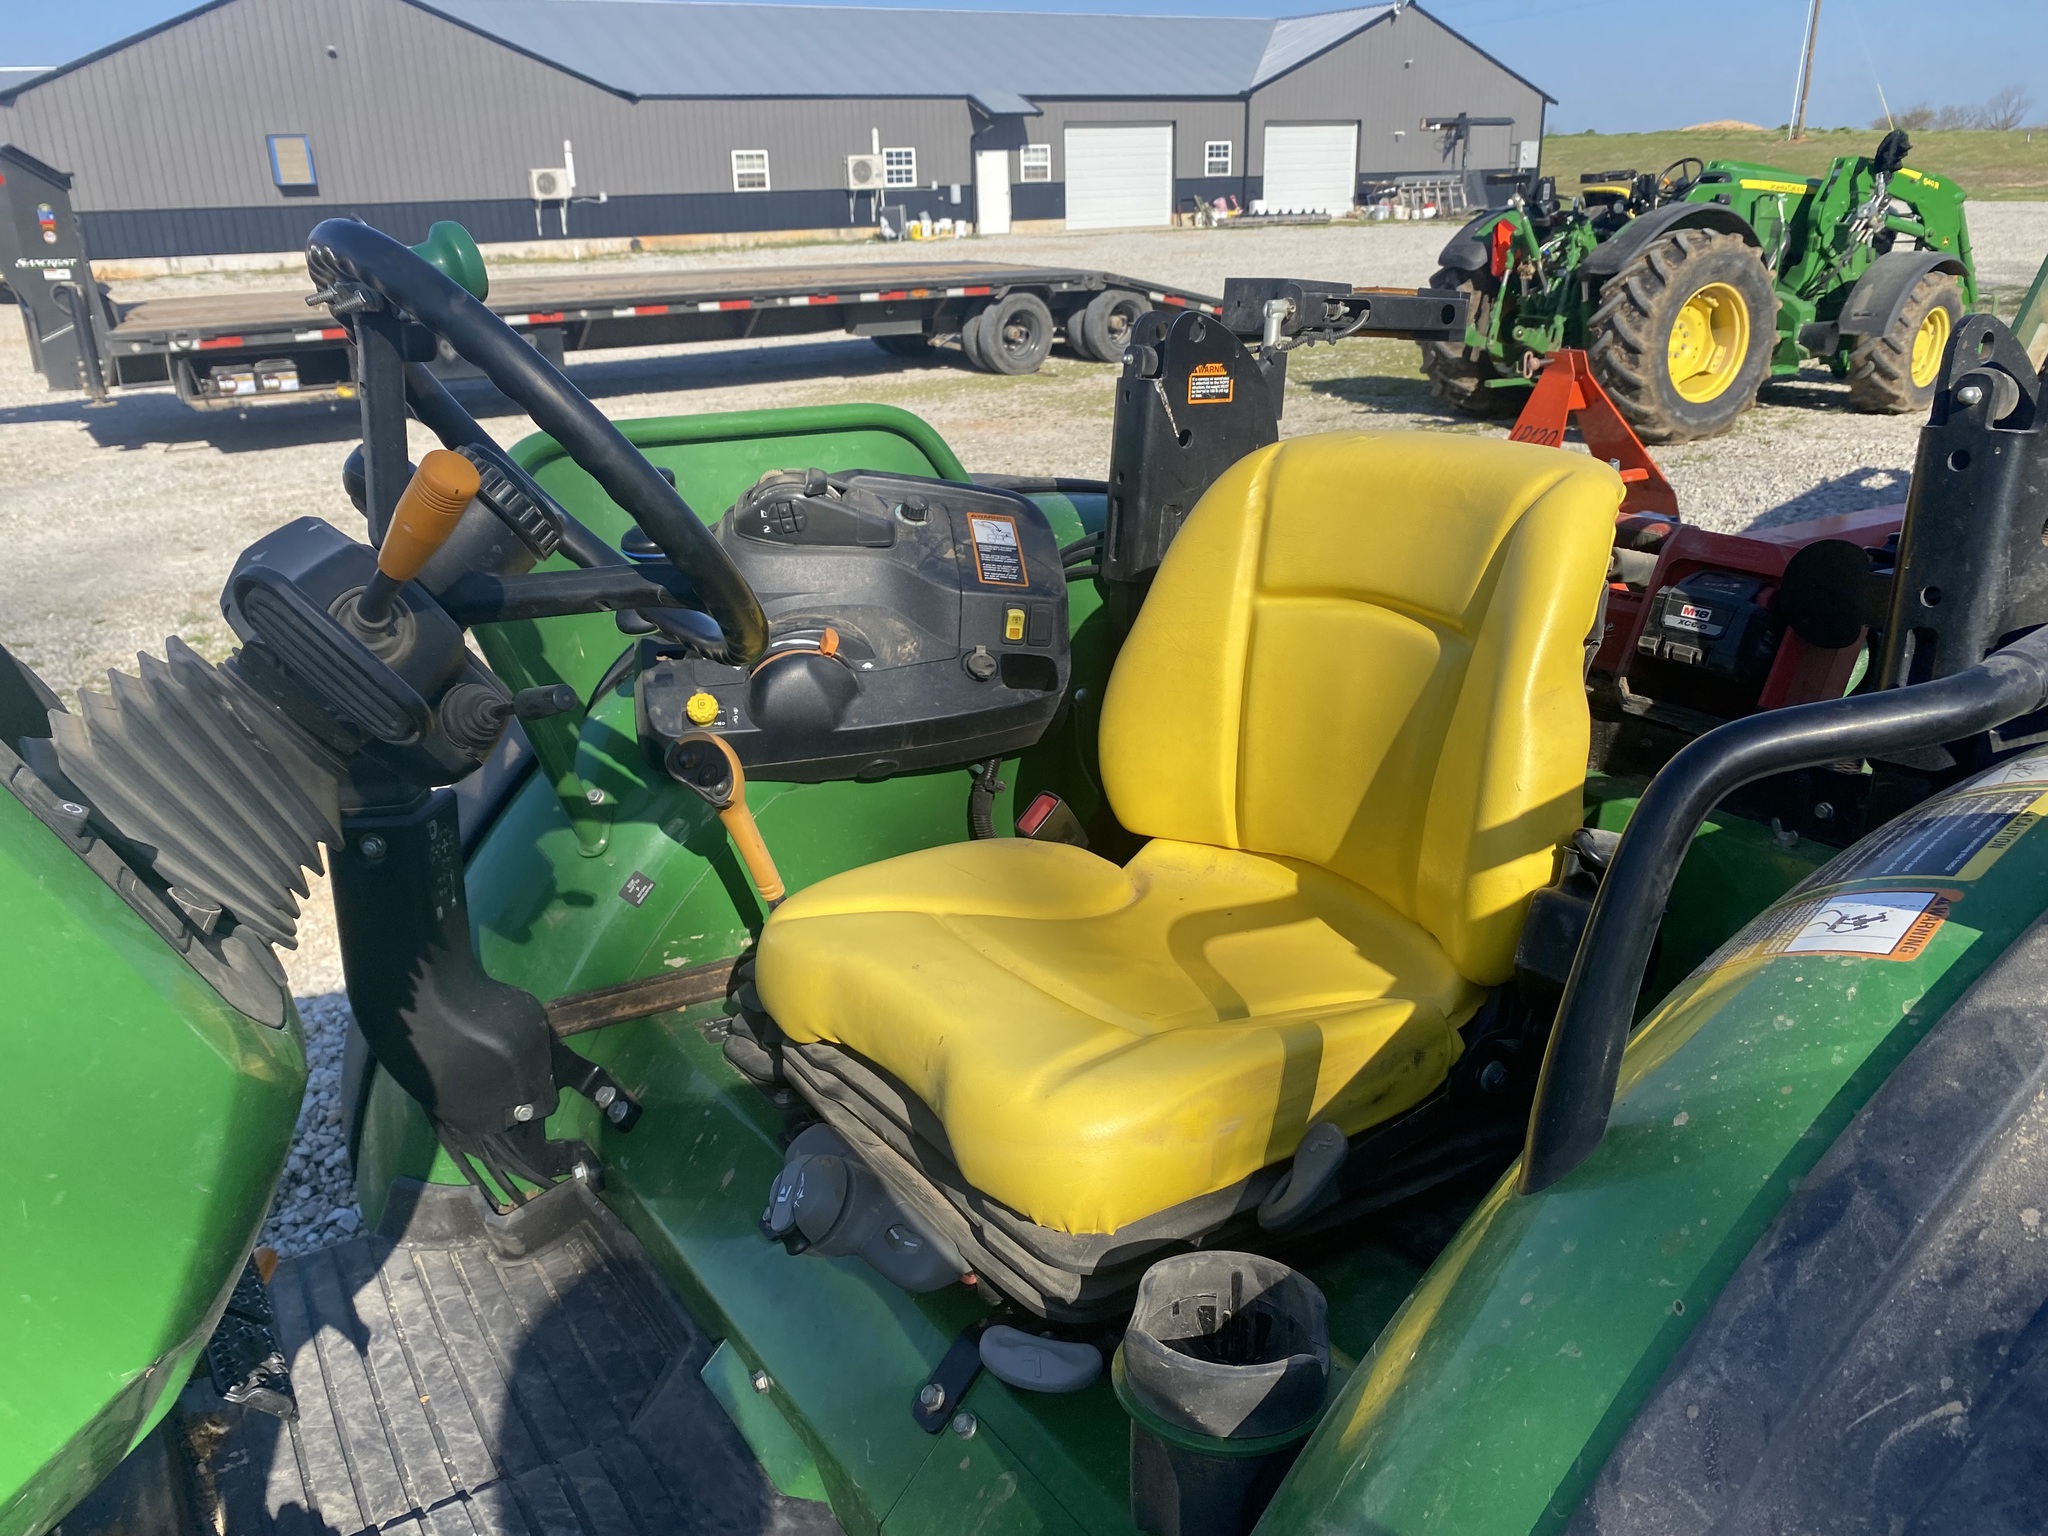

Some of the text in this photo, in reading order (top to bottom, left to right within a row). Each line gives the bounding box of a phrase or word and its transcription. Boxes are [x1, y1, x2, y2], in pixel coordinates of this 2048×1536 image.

[1682, 606, 1709, 619] M18
[1987, 816, 2033, 849] CAUTION
[1899, 906, 1949, 954] WARNING
